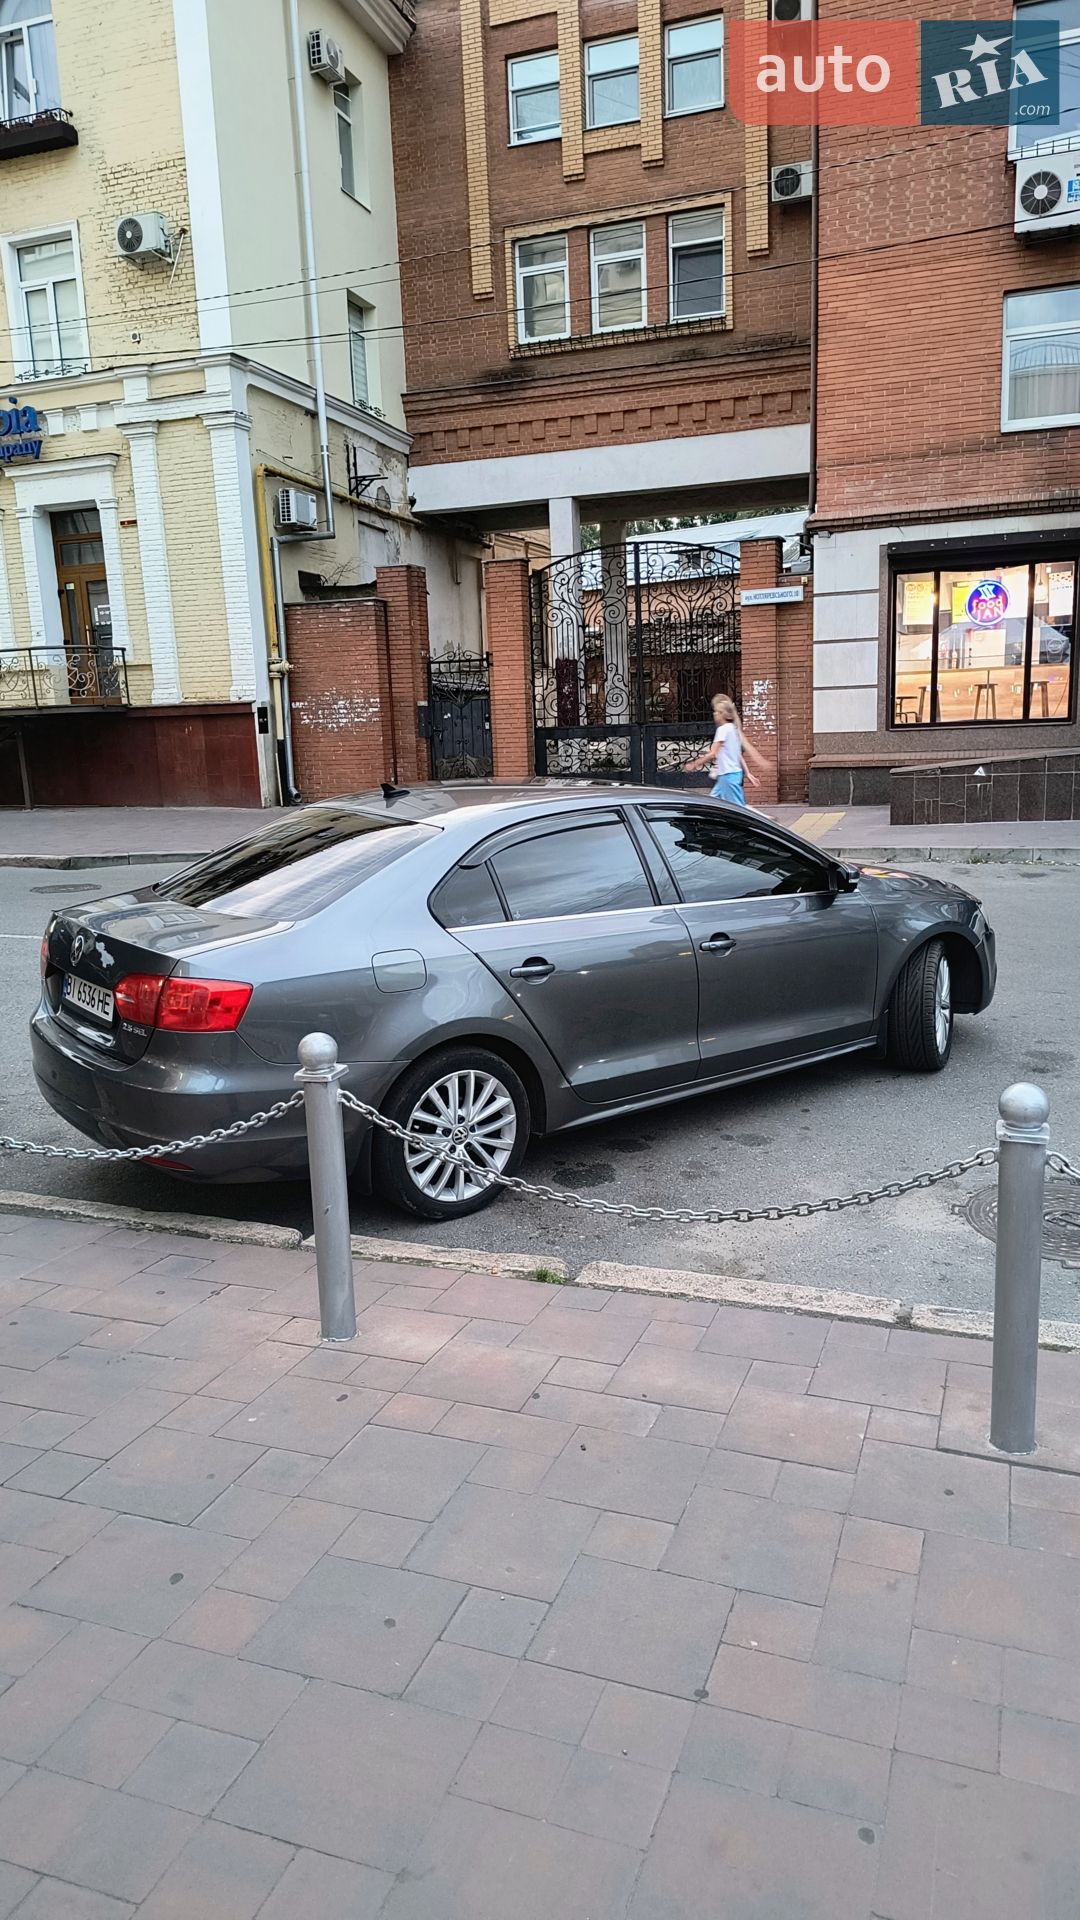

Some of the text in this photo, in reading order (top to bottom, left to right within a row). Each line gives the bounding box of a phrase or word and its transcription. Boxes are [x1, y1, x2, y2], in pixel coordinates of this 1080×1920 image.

[971, 595, 1004, 614] food
[67, 975, 111, 1016] BI 6536 HE
[132, 1026, 148, 1037] SEL
